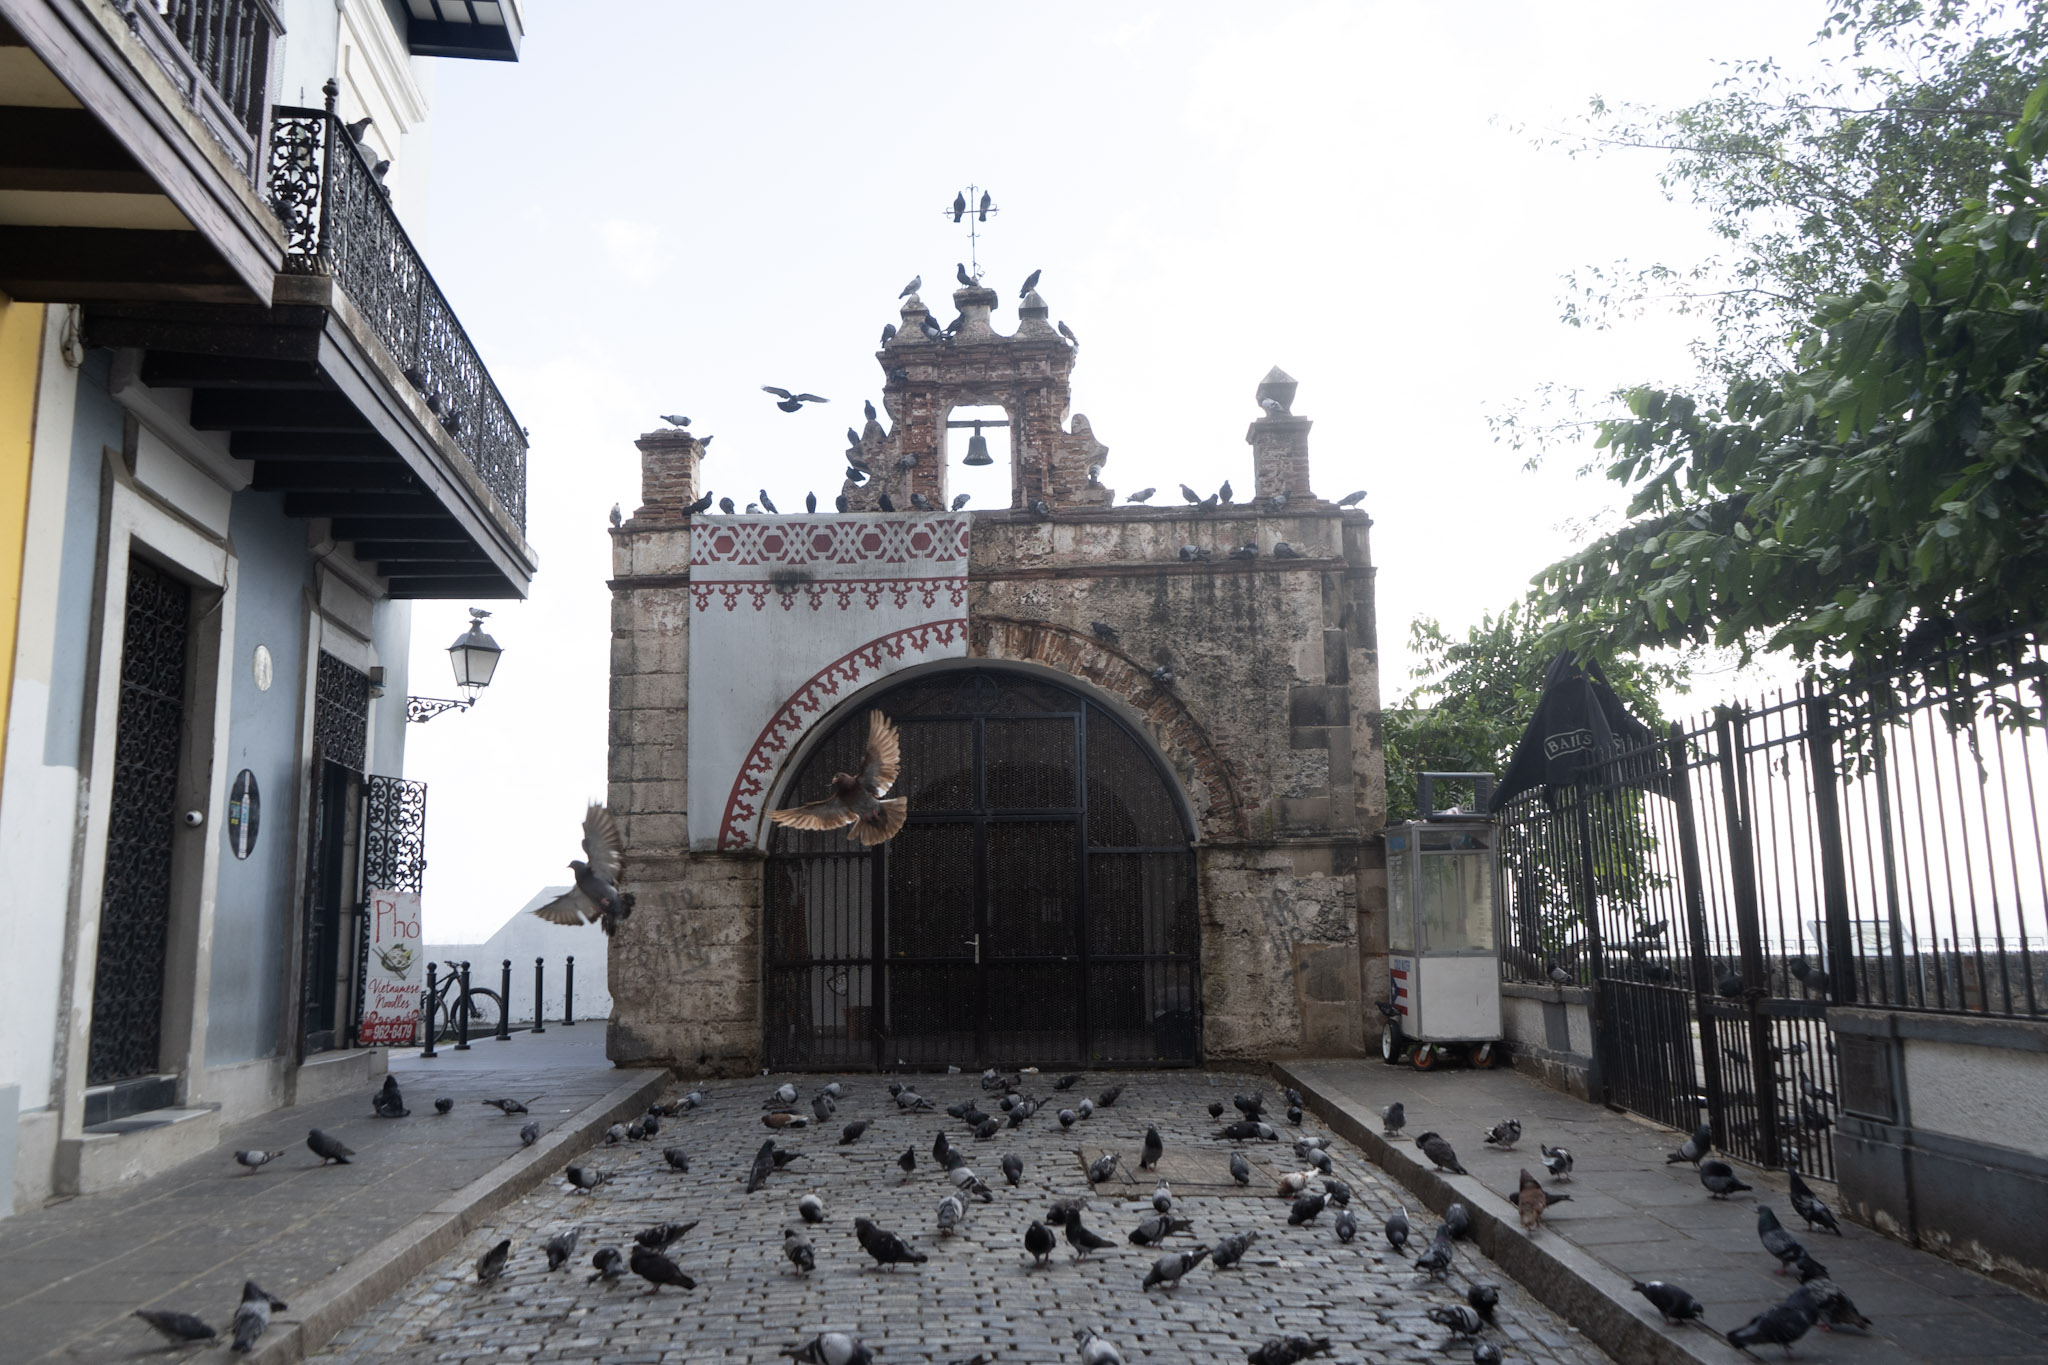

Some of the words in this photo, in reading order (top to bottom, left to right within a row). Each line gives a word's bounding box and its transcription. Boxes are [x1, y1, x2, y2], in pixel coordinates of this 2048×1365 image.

[368, 978, 420, 994] Vietnamese
[375, 994, 410, 1009] Noodles
[373, 1024, 413, 1040] 962-6479
